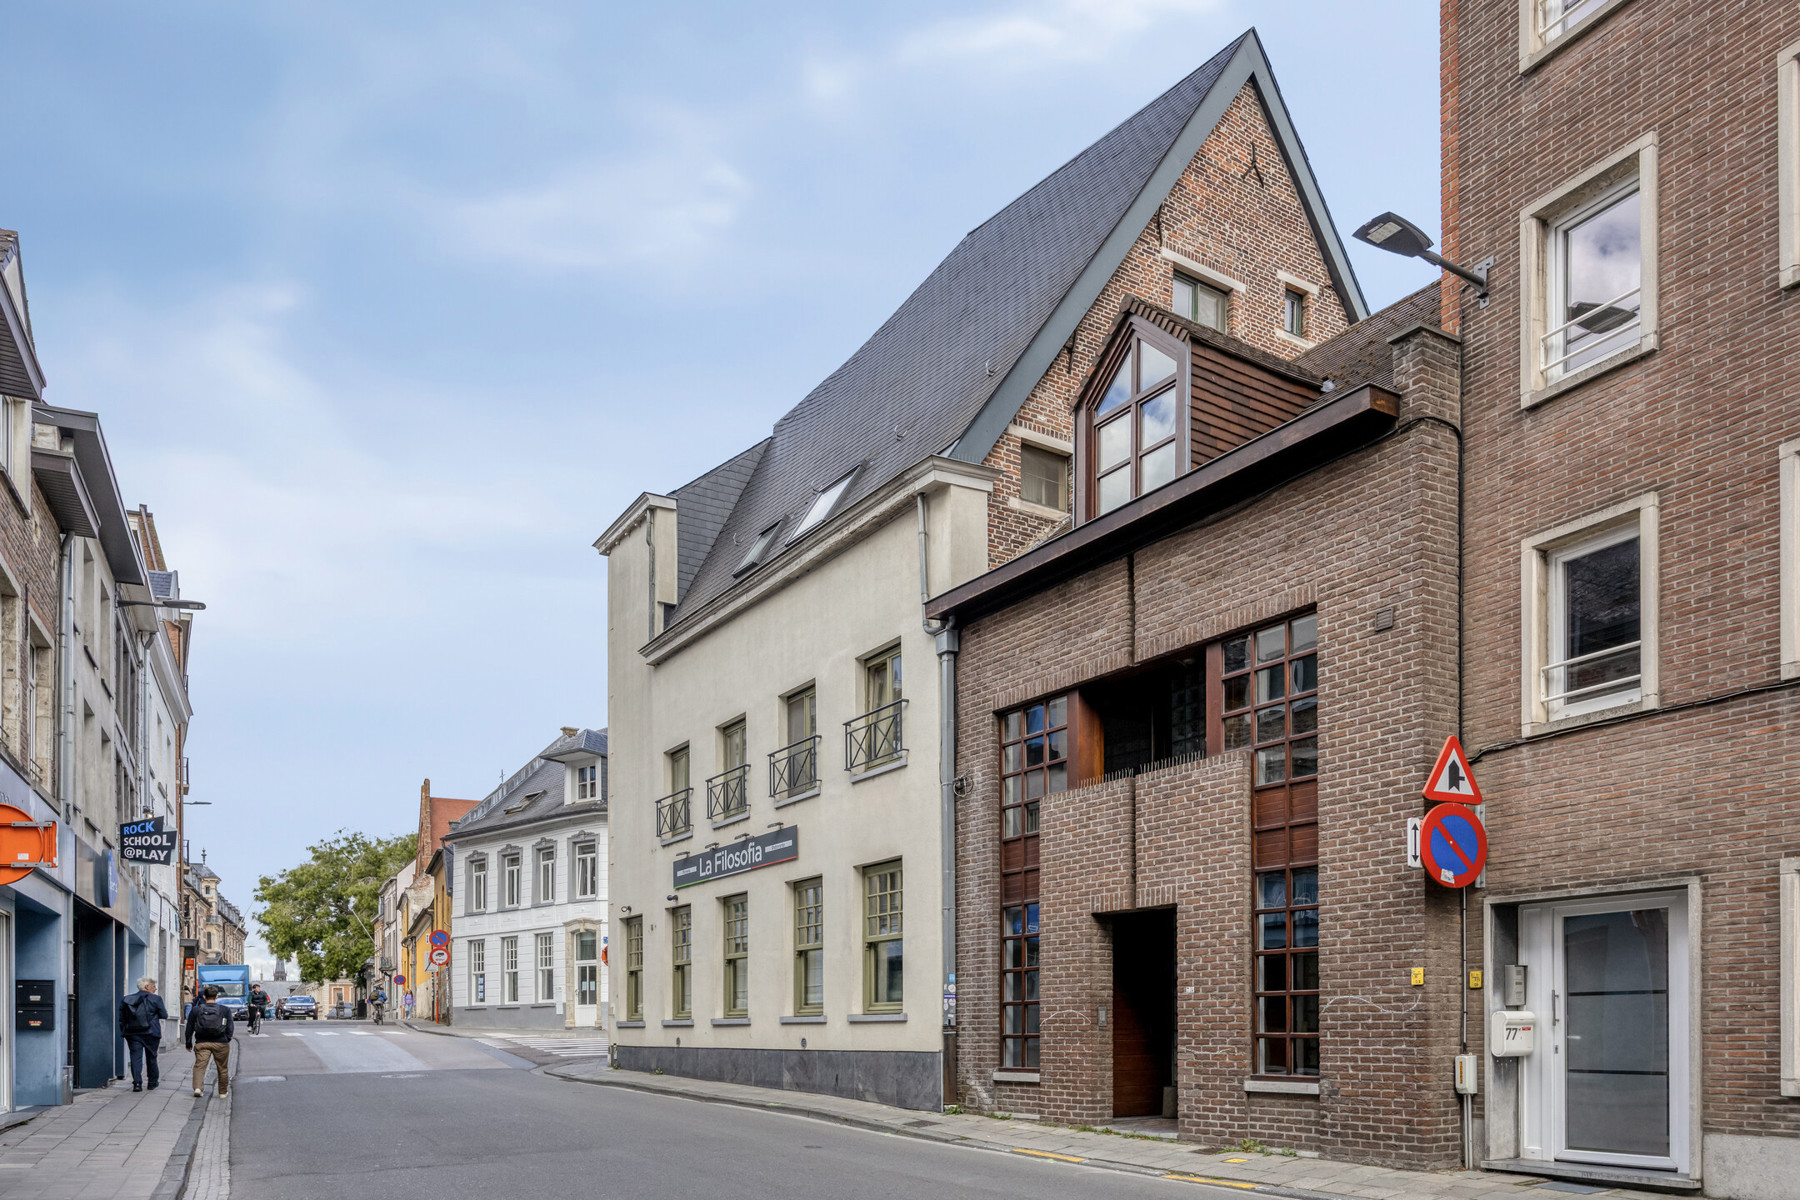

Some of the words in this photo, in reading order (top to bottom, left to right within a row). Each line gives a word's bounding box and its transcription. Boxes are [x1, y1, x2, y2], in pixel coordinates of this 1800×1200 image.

[123, 820, 155, 835] ROCK
[123, 834, 171, 846] SCHOOL
[124, 847, 168, 861] @PLAY
[699, 858, 712, 877] La
[714, 841, 763, 873] Filosofia
